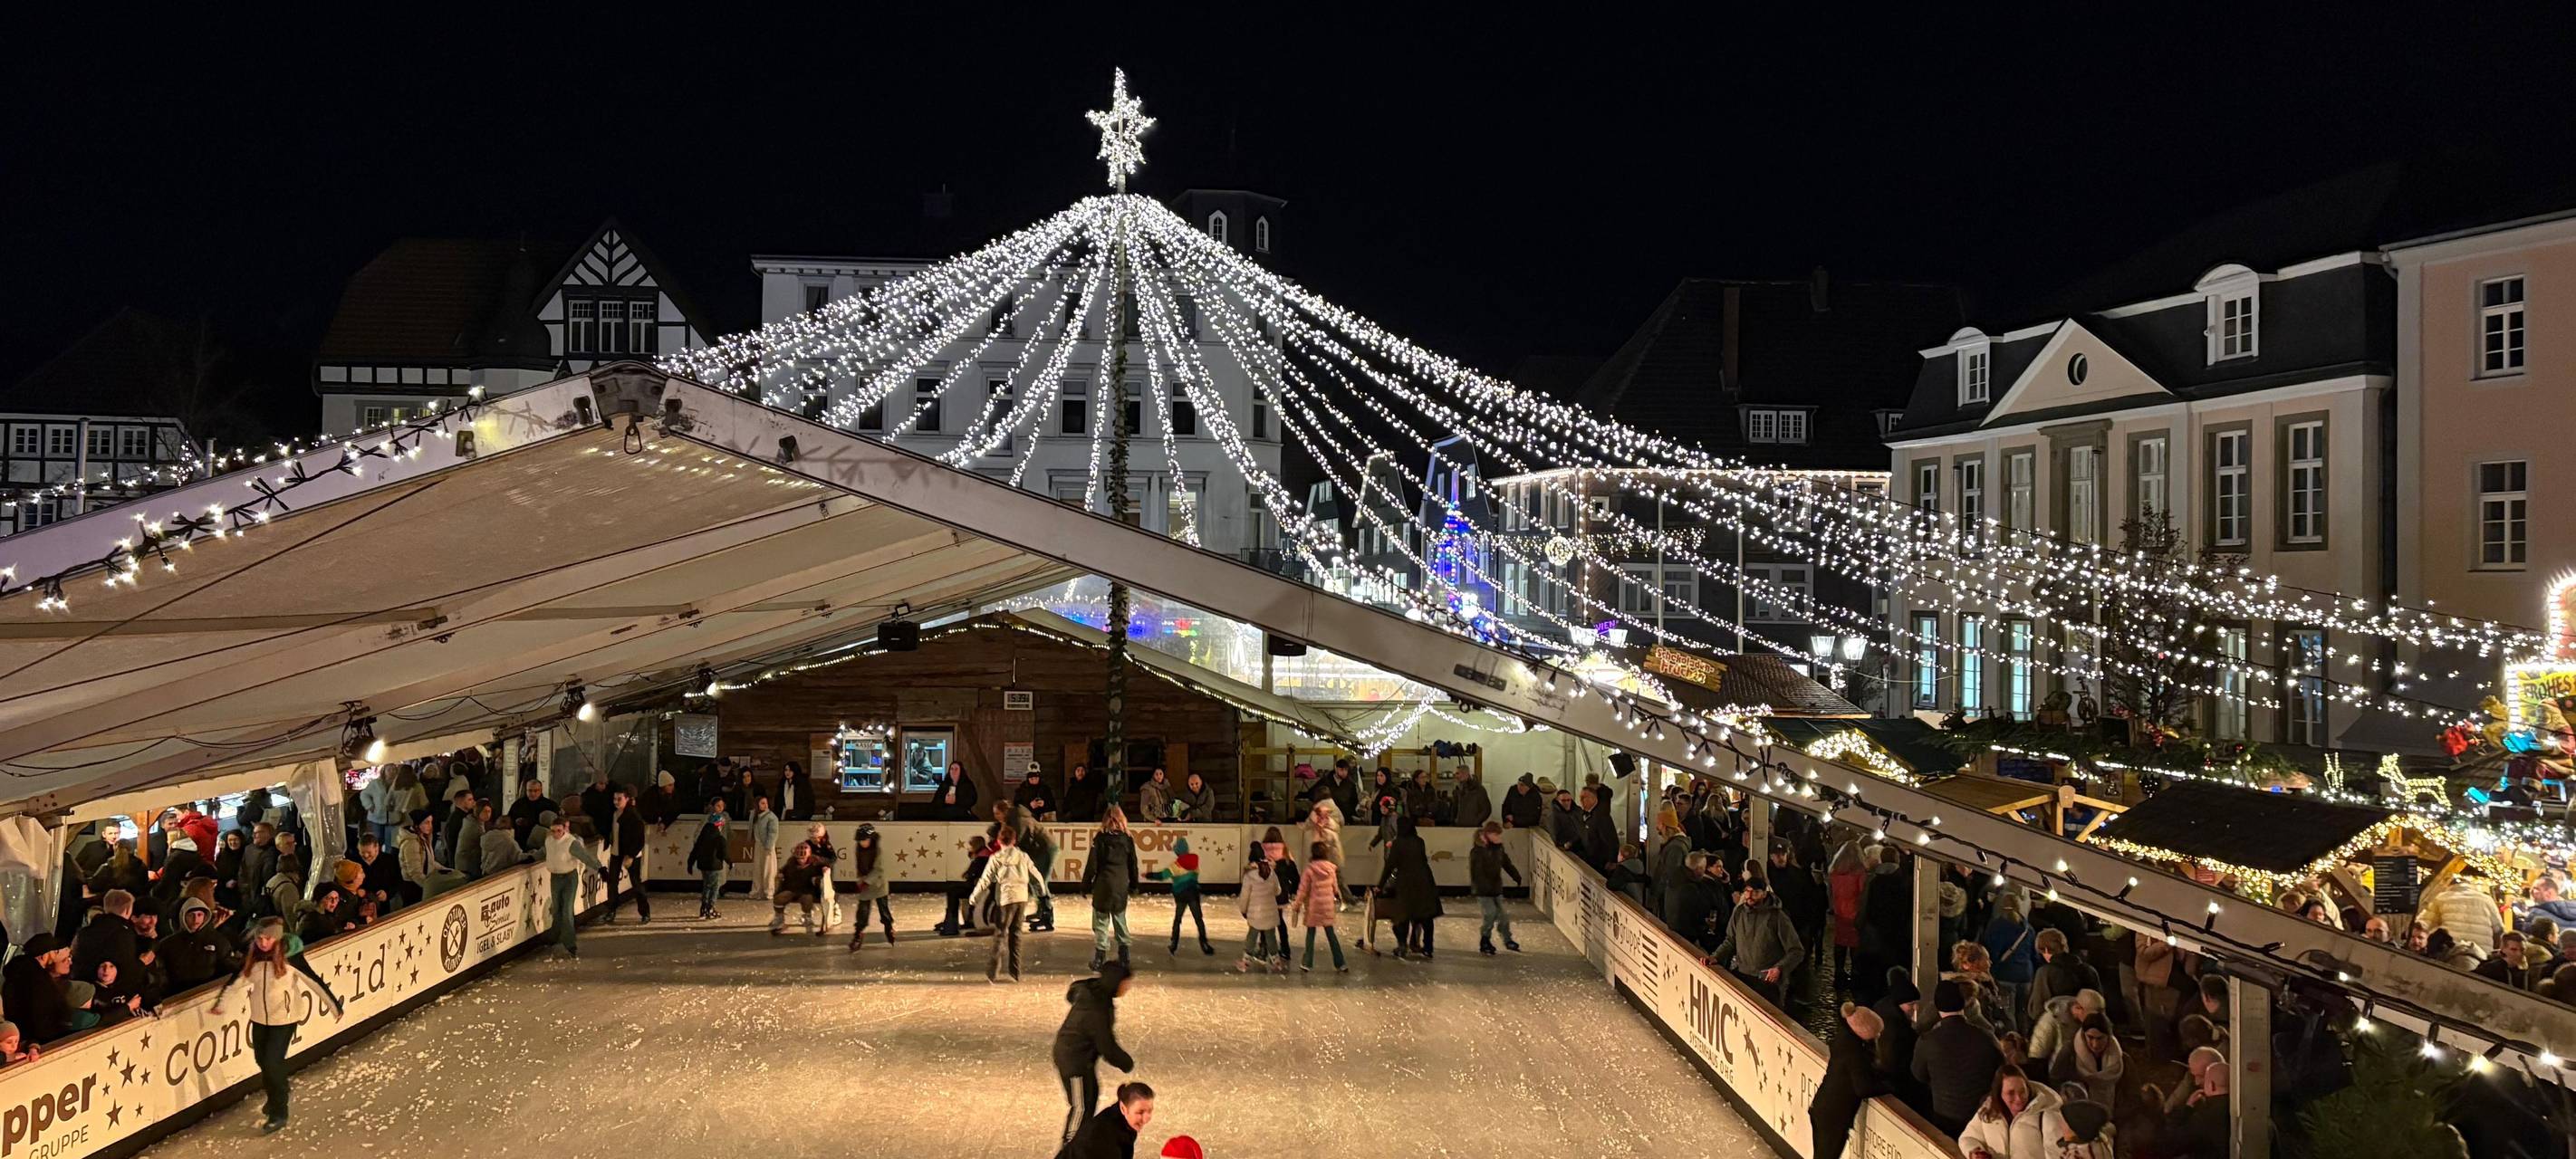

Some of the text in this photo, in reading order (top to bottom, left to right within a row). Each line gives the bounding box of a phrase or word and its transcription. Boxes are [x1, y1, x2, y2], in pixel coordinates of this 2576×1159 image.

[2523, 675, 2572, 702] FROHES
[490, 894, 510, 914] auto
[476, 926, 514, 954] IGEL & SLABY
[165, 943, 386, 1087] conpt.id
[1689, 1030, 1734, 1084] SYSTEMHAUS OHG
